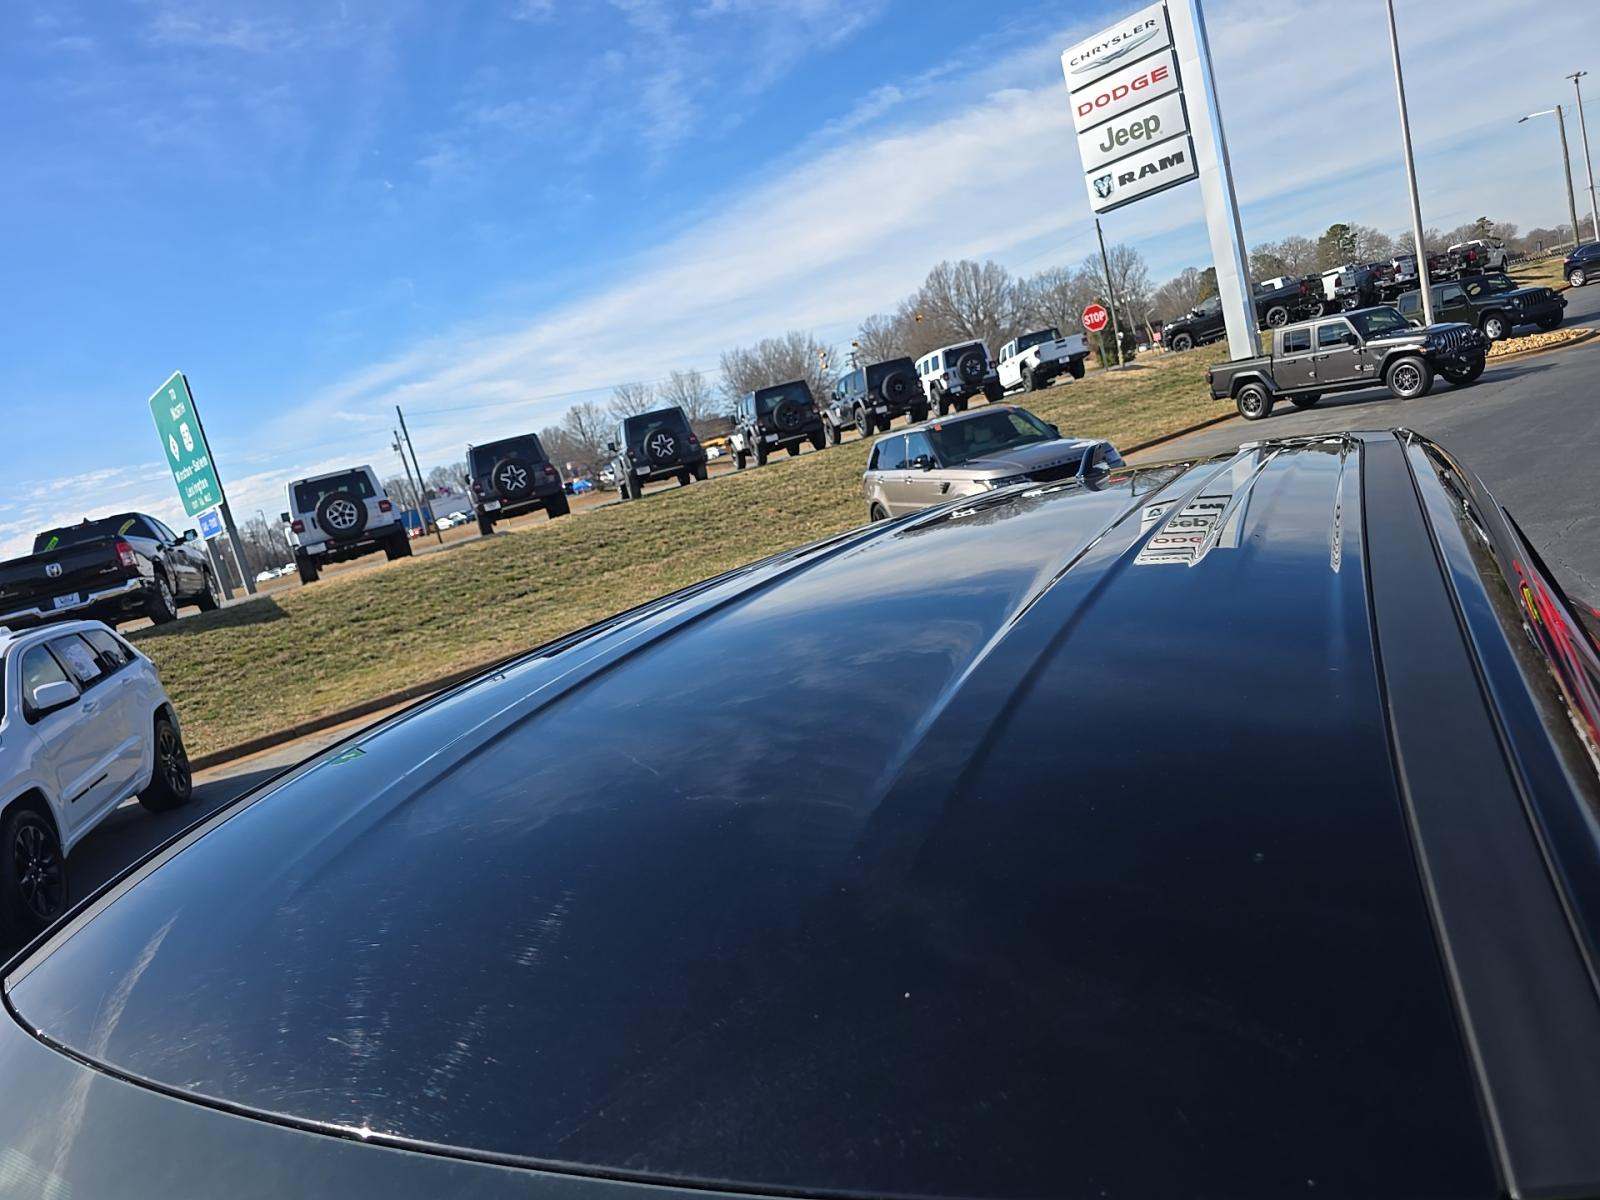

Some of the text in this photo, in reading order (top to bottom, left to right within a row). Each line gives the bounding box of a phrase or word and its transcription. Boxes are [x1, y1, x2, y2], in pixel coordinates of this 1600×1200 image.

[1070, 19, 1155, 67] CHRYSLER
[1077, 65, 1169, 117] DODGE
[1099, 114, 1161, 153] Jeep
[1118, 151, 1185, 187] RAM
[1084, 310, 1105, 326] STOP
